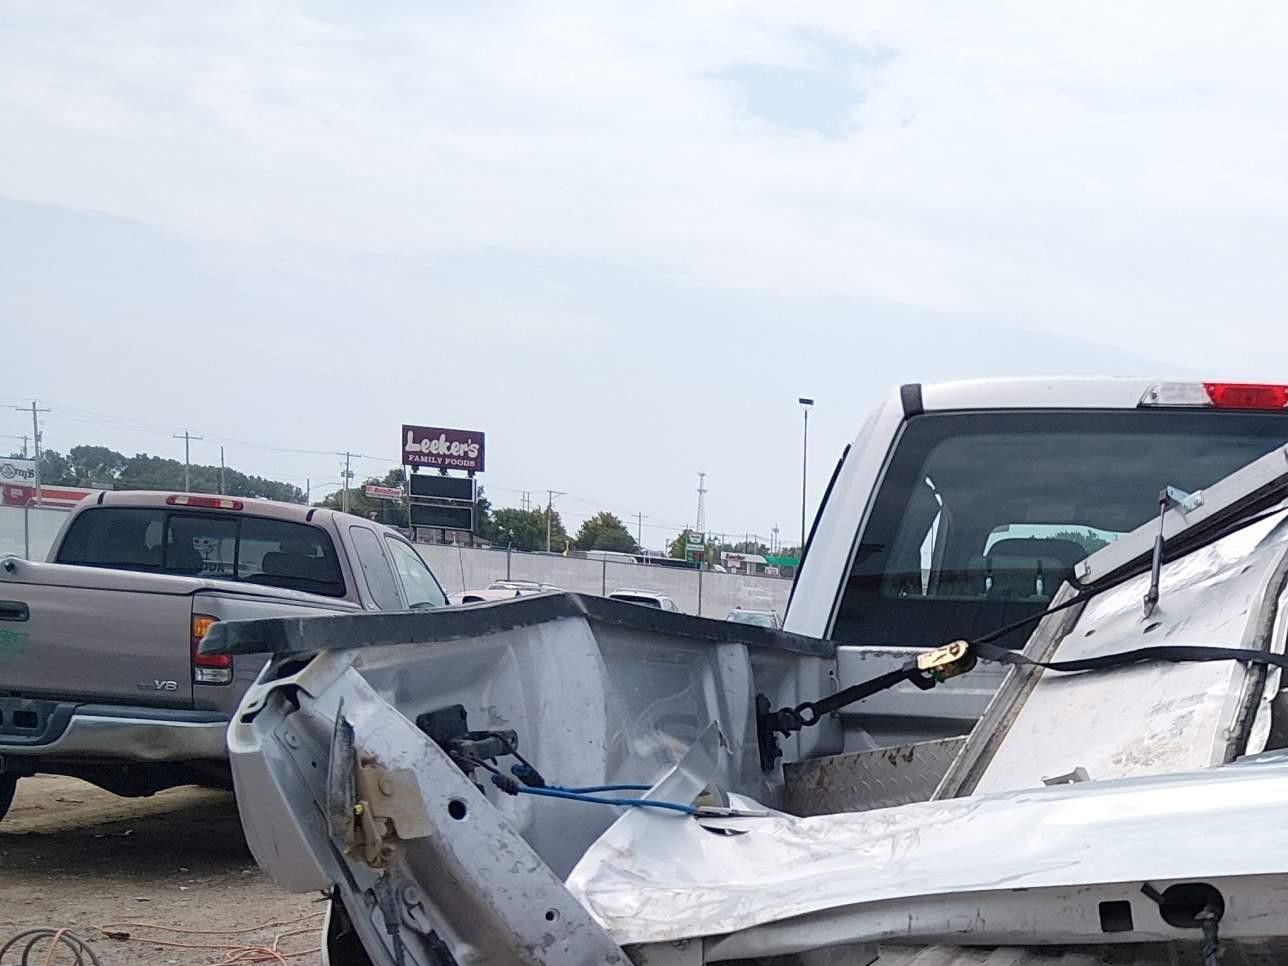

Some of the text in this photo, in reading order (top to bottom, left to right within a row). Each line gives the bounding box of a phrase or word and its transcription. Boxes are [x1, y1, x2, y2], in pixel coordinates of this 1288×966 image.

[405, 430, 480, 458] Leeker's
[408, 455, 475, 467] FAMILY FOODS
[153, 679, 178, 691] V8
